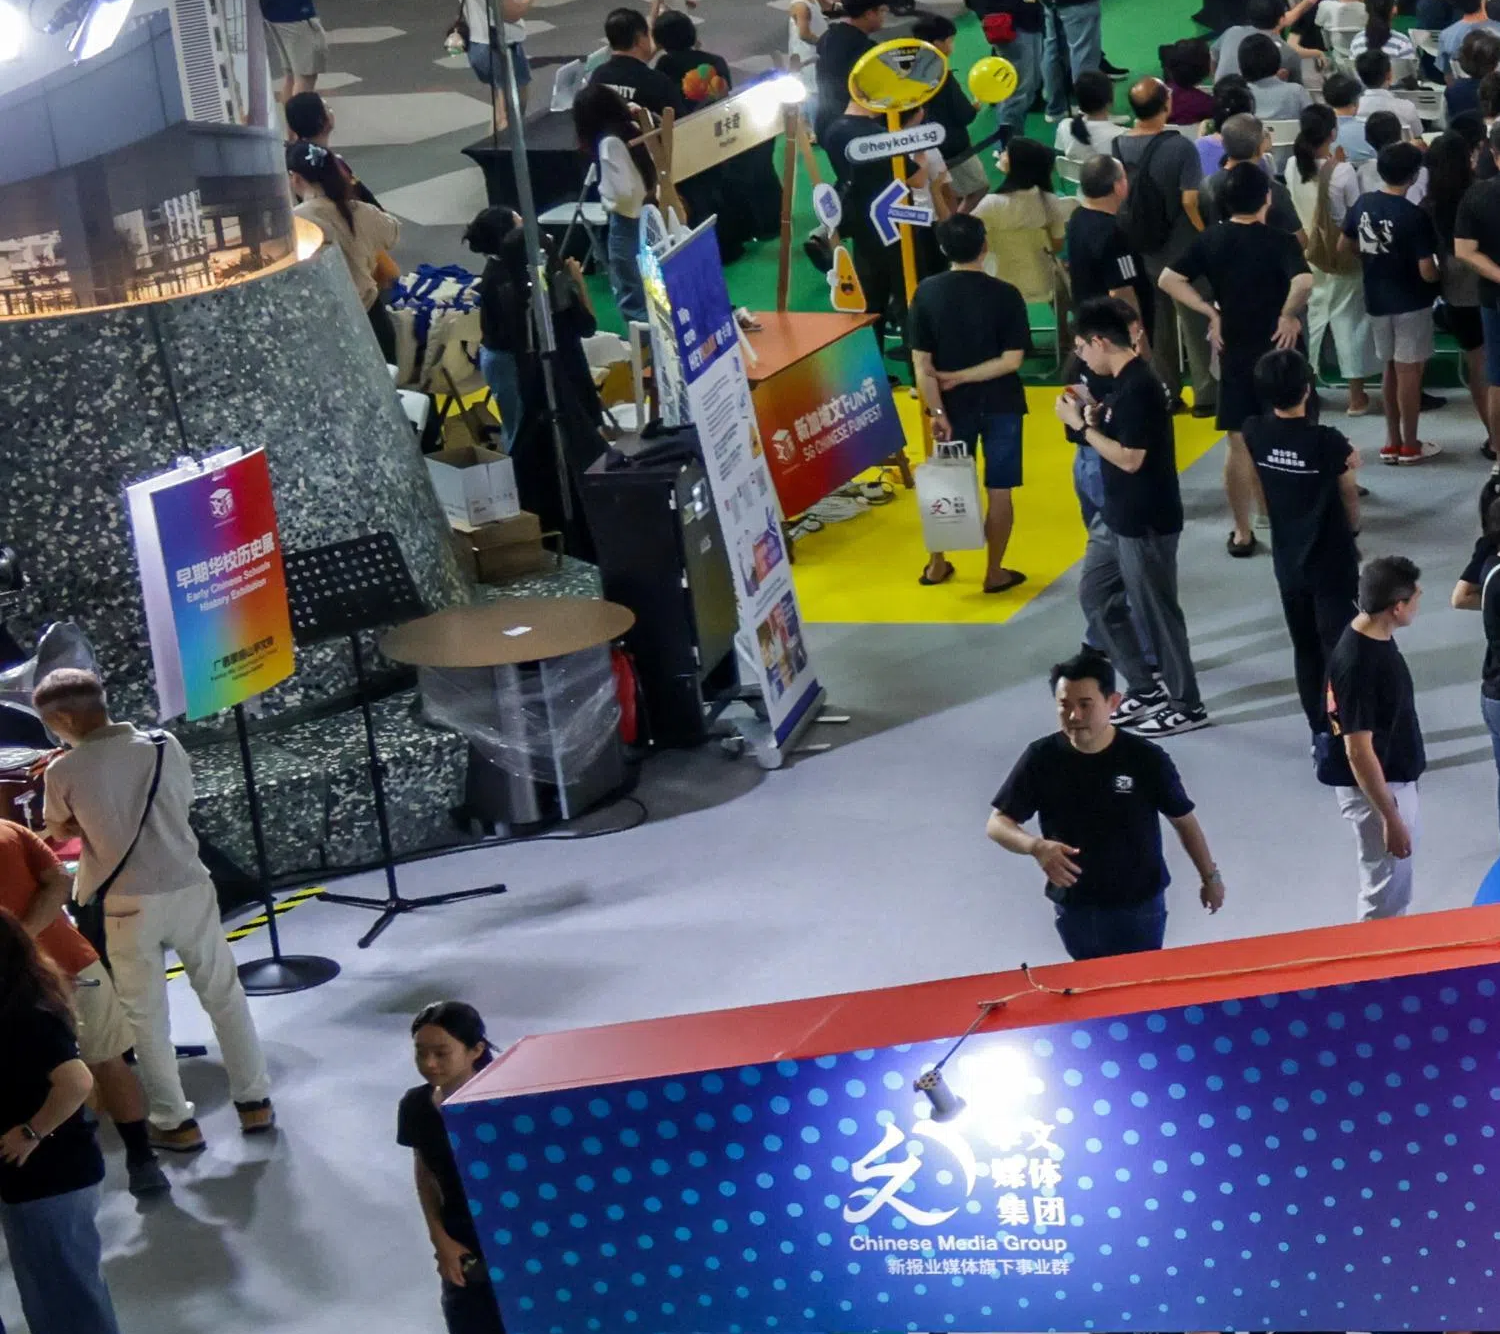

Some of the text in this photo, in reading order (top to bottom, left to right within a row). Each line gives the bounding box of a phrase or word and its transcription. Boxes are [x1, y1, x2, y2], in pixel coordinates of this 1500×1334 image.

[858, 128, 938, 156] @heykaki.sg
[990, 1156, 1065, 1190] 媒体
[997, 1194, 1067, 1228] 集团
[848, 1234, 1069, 1255] Chinese Media Group
[886, 1257, 1071, 1277] 新报业媒体旗下事业群
